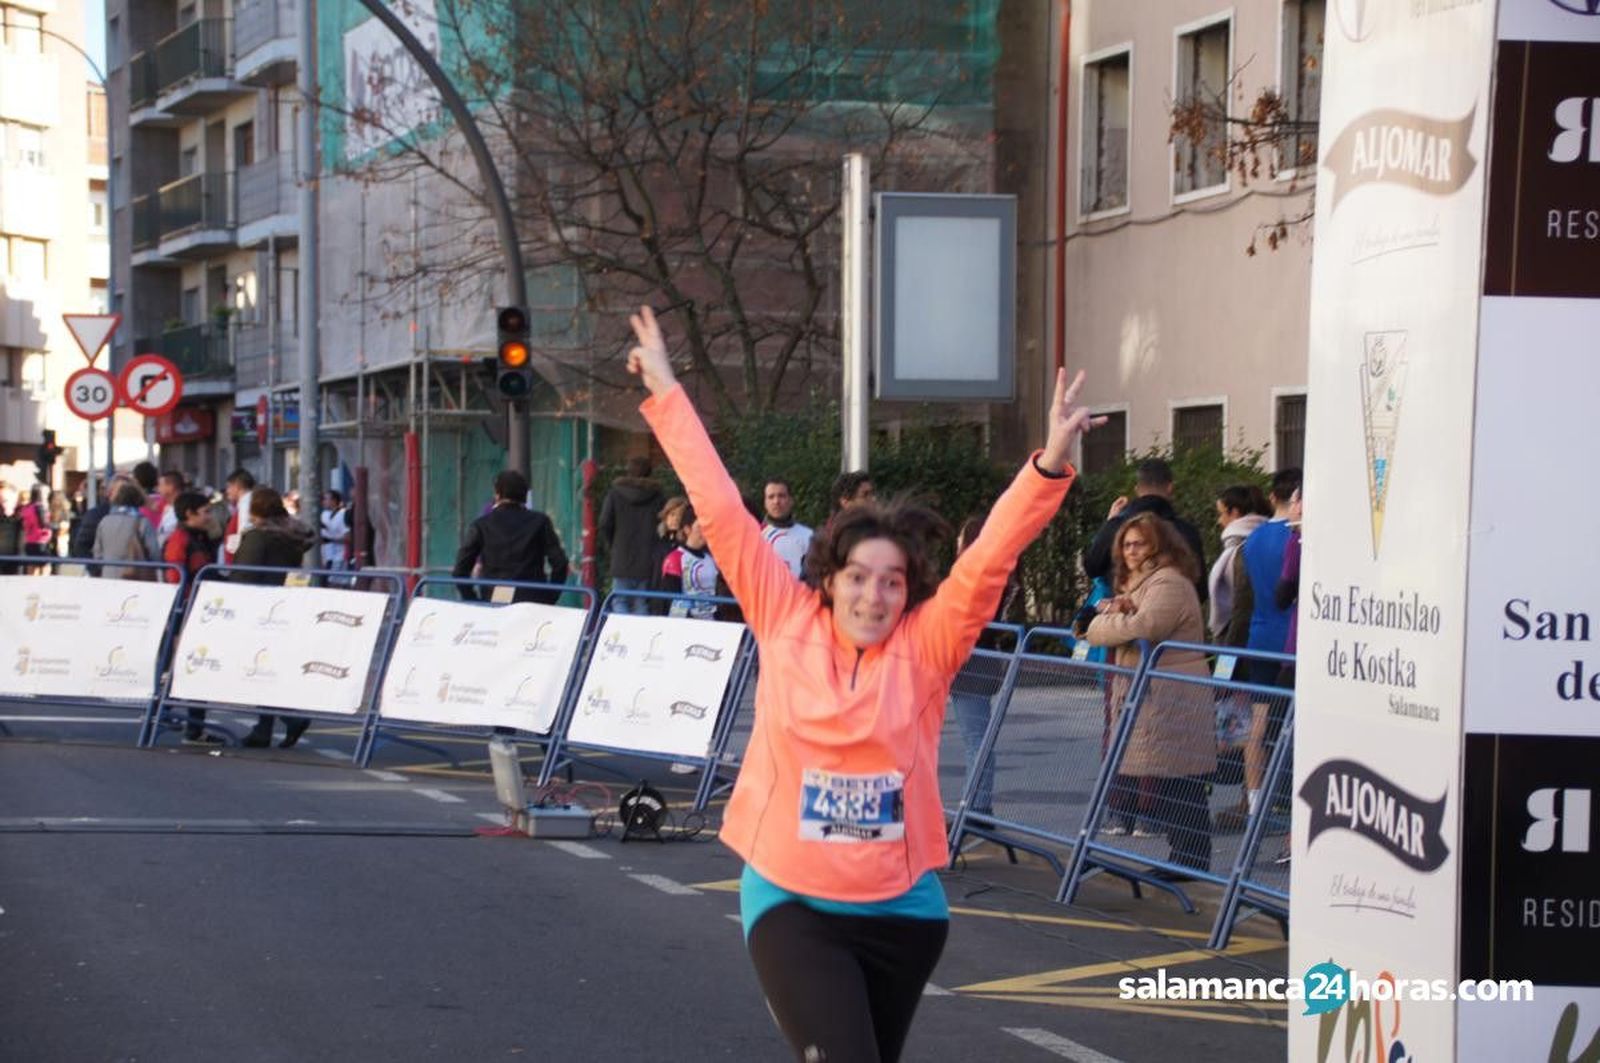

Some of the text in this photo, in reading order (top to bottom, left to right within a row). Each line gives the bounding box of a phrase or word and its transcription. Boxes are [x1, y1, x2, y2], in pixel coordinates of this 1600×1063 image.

[1351, 125, 1452, 182] ALJOMAR
[76, 385, 107, 403] 30
[1310, 581, 1441, 635] San Estanislao
[1503, 598, 1591, 641] San
[1327, 639, 1416, 688] de Kostka
[1388, 693, 1440, 722] Salamanca
[813, 788, 881, 820] 4333
[1325, 773, 1426, 859] ALJOMAR
